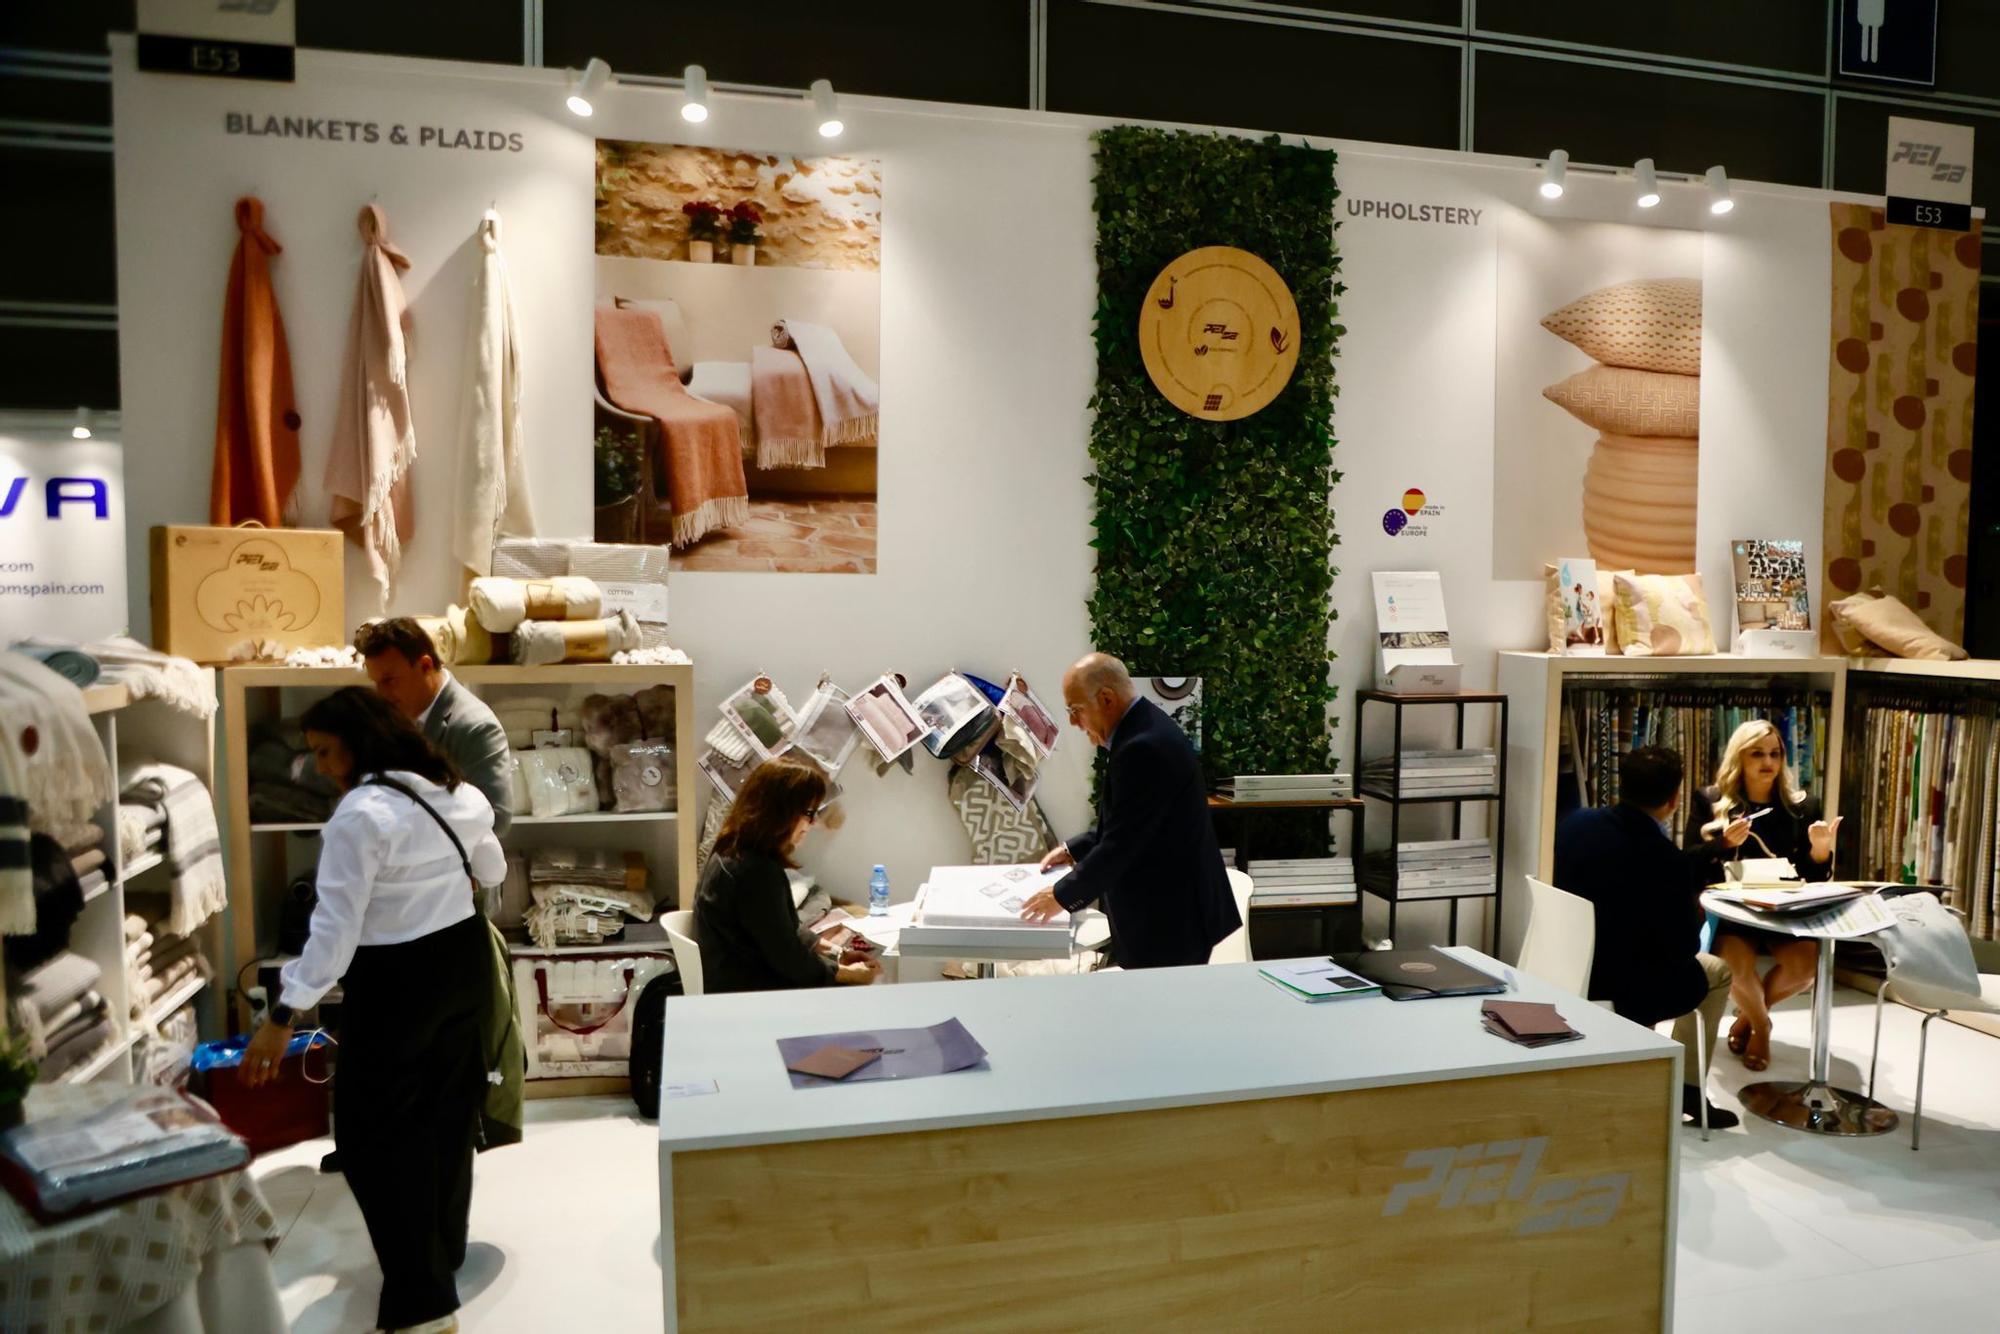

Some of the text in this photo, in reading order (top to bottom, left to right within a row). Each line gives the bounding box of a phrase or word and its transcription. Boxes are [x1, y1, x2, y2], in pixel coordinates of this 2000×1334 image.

[193, 45, 241, 73] E53
[225, 111, 525, 153] BLANKETS & PLAIDS
[1346, 198, 1483, 226] UPHOLSTERY
[1915, 204, 1943, 225] E53
[1420, 509, 1441, 517] SPAIN
